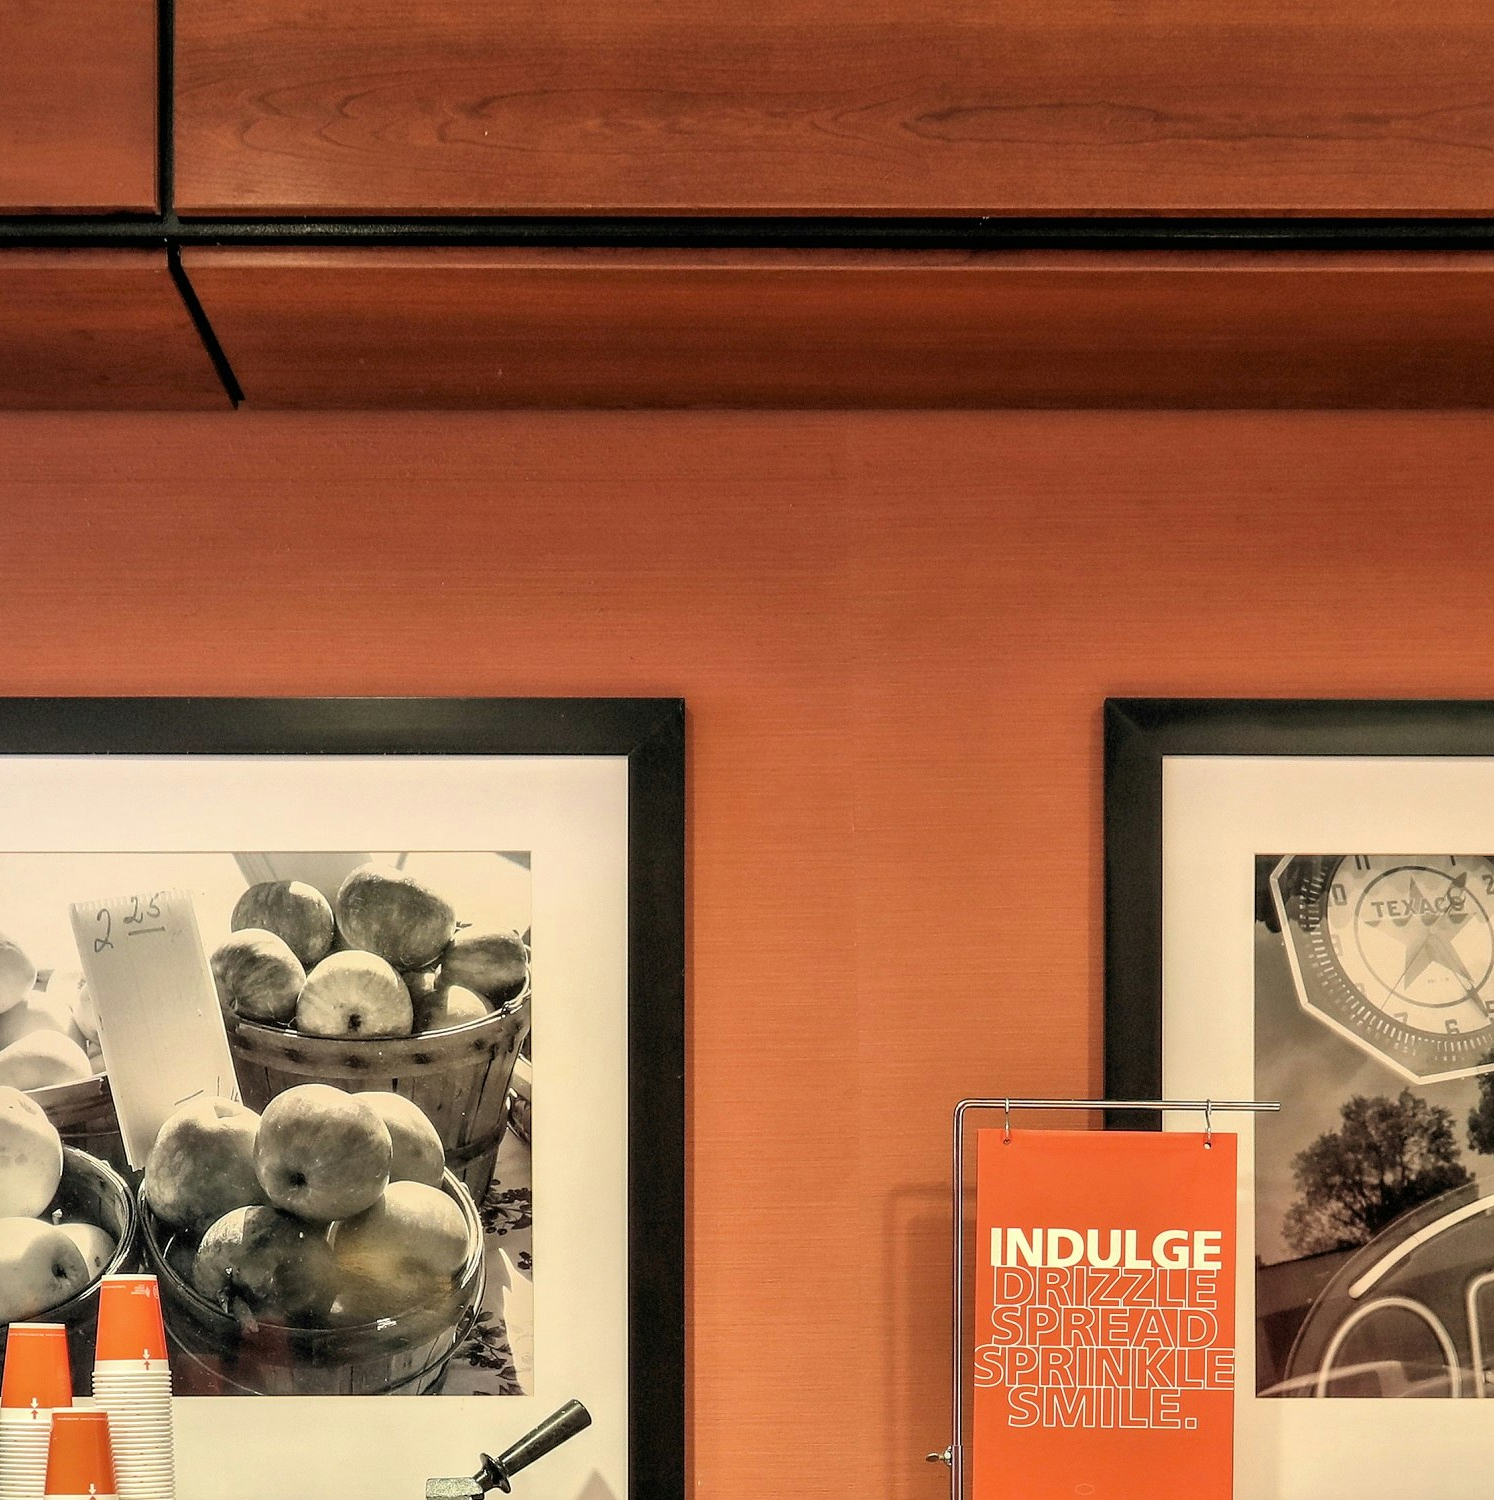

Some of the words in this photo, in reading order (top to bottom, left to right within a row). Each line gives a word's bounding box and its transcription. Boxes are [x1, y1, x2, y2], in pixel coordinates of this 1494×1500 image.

[1370, 896, 1465, 918] TEXACO
[991, 1228, 1222, 1269] INDULGE
[994, 1266, 1217, 1310] DRIZZLE
[991, 1306, 1218, 1350] SPREAD
[974, 1344, 1235, 1390] SPRINKLE
[1008, 1385, 1198, 1429] SMILE.
